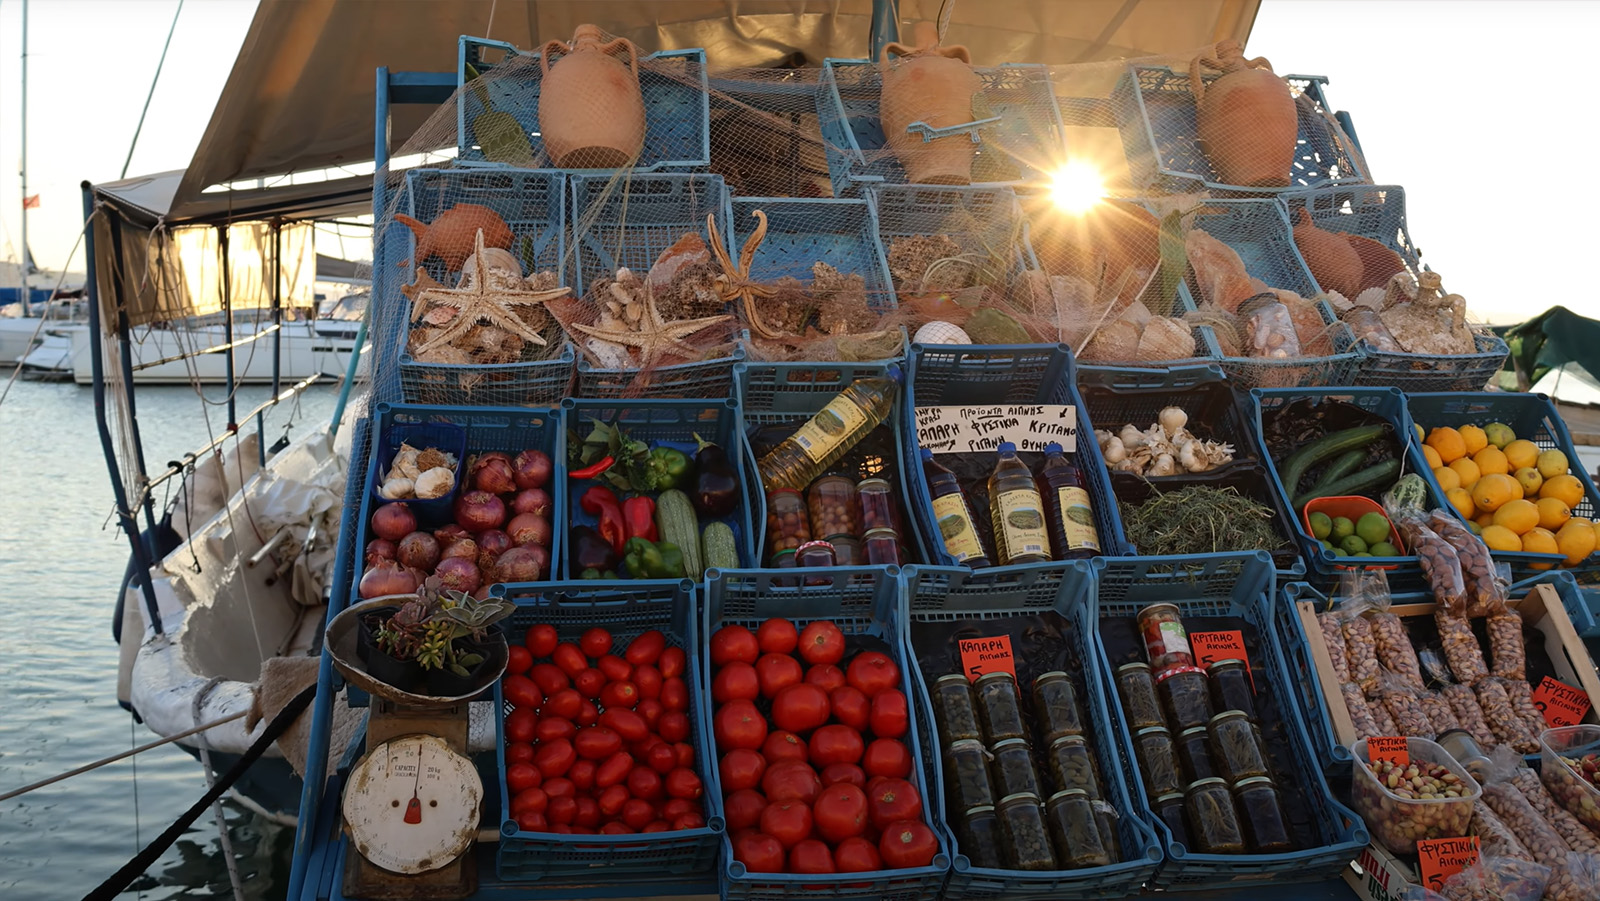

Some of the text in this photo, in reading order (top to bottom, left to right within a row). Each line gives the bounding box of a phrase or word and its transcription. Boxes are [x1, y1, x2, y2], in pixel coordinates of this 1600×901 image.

[971, 418, 1019, 436] ΦΥΣΤΙΚΙΑ
[1029, 420, 1077, 436] ΚΡΙΤΑΜΟ
[1192, 633, 1233, 644] ΚΡΙΤΑΜΟ
[961, 640, 1004, 653] ΚΑΠΑΡΗ
[1541, 679, 1591, 709] ΦΥΣΤΙΚΙΑ
[1368, 738, 1408, 749] ΦΥΣΤΙΚΙΑ
[1420, 841, 1479, 860] ΦΥΣΤΙΚΙΑ
